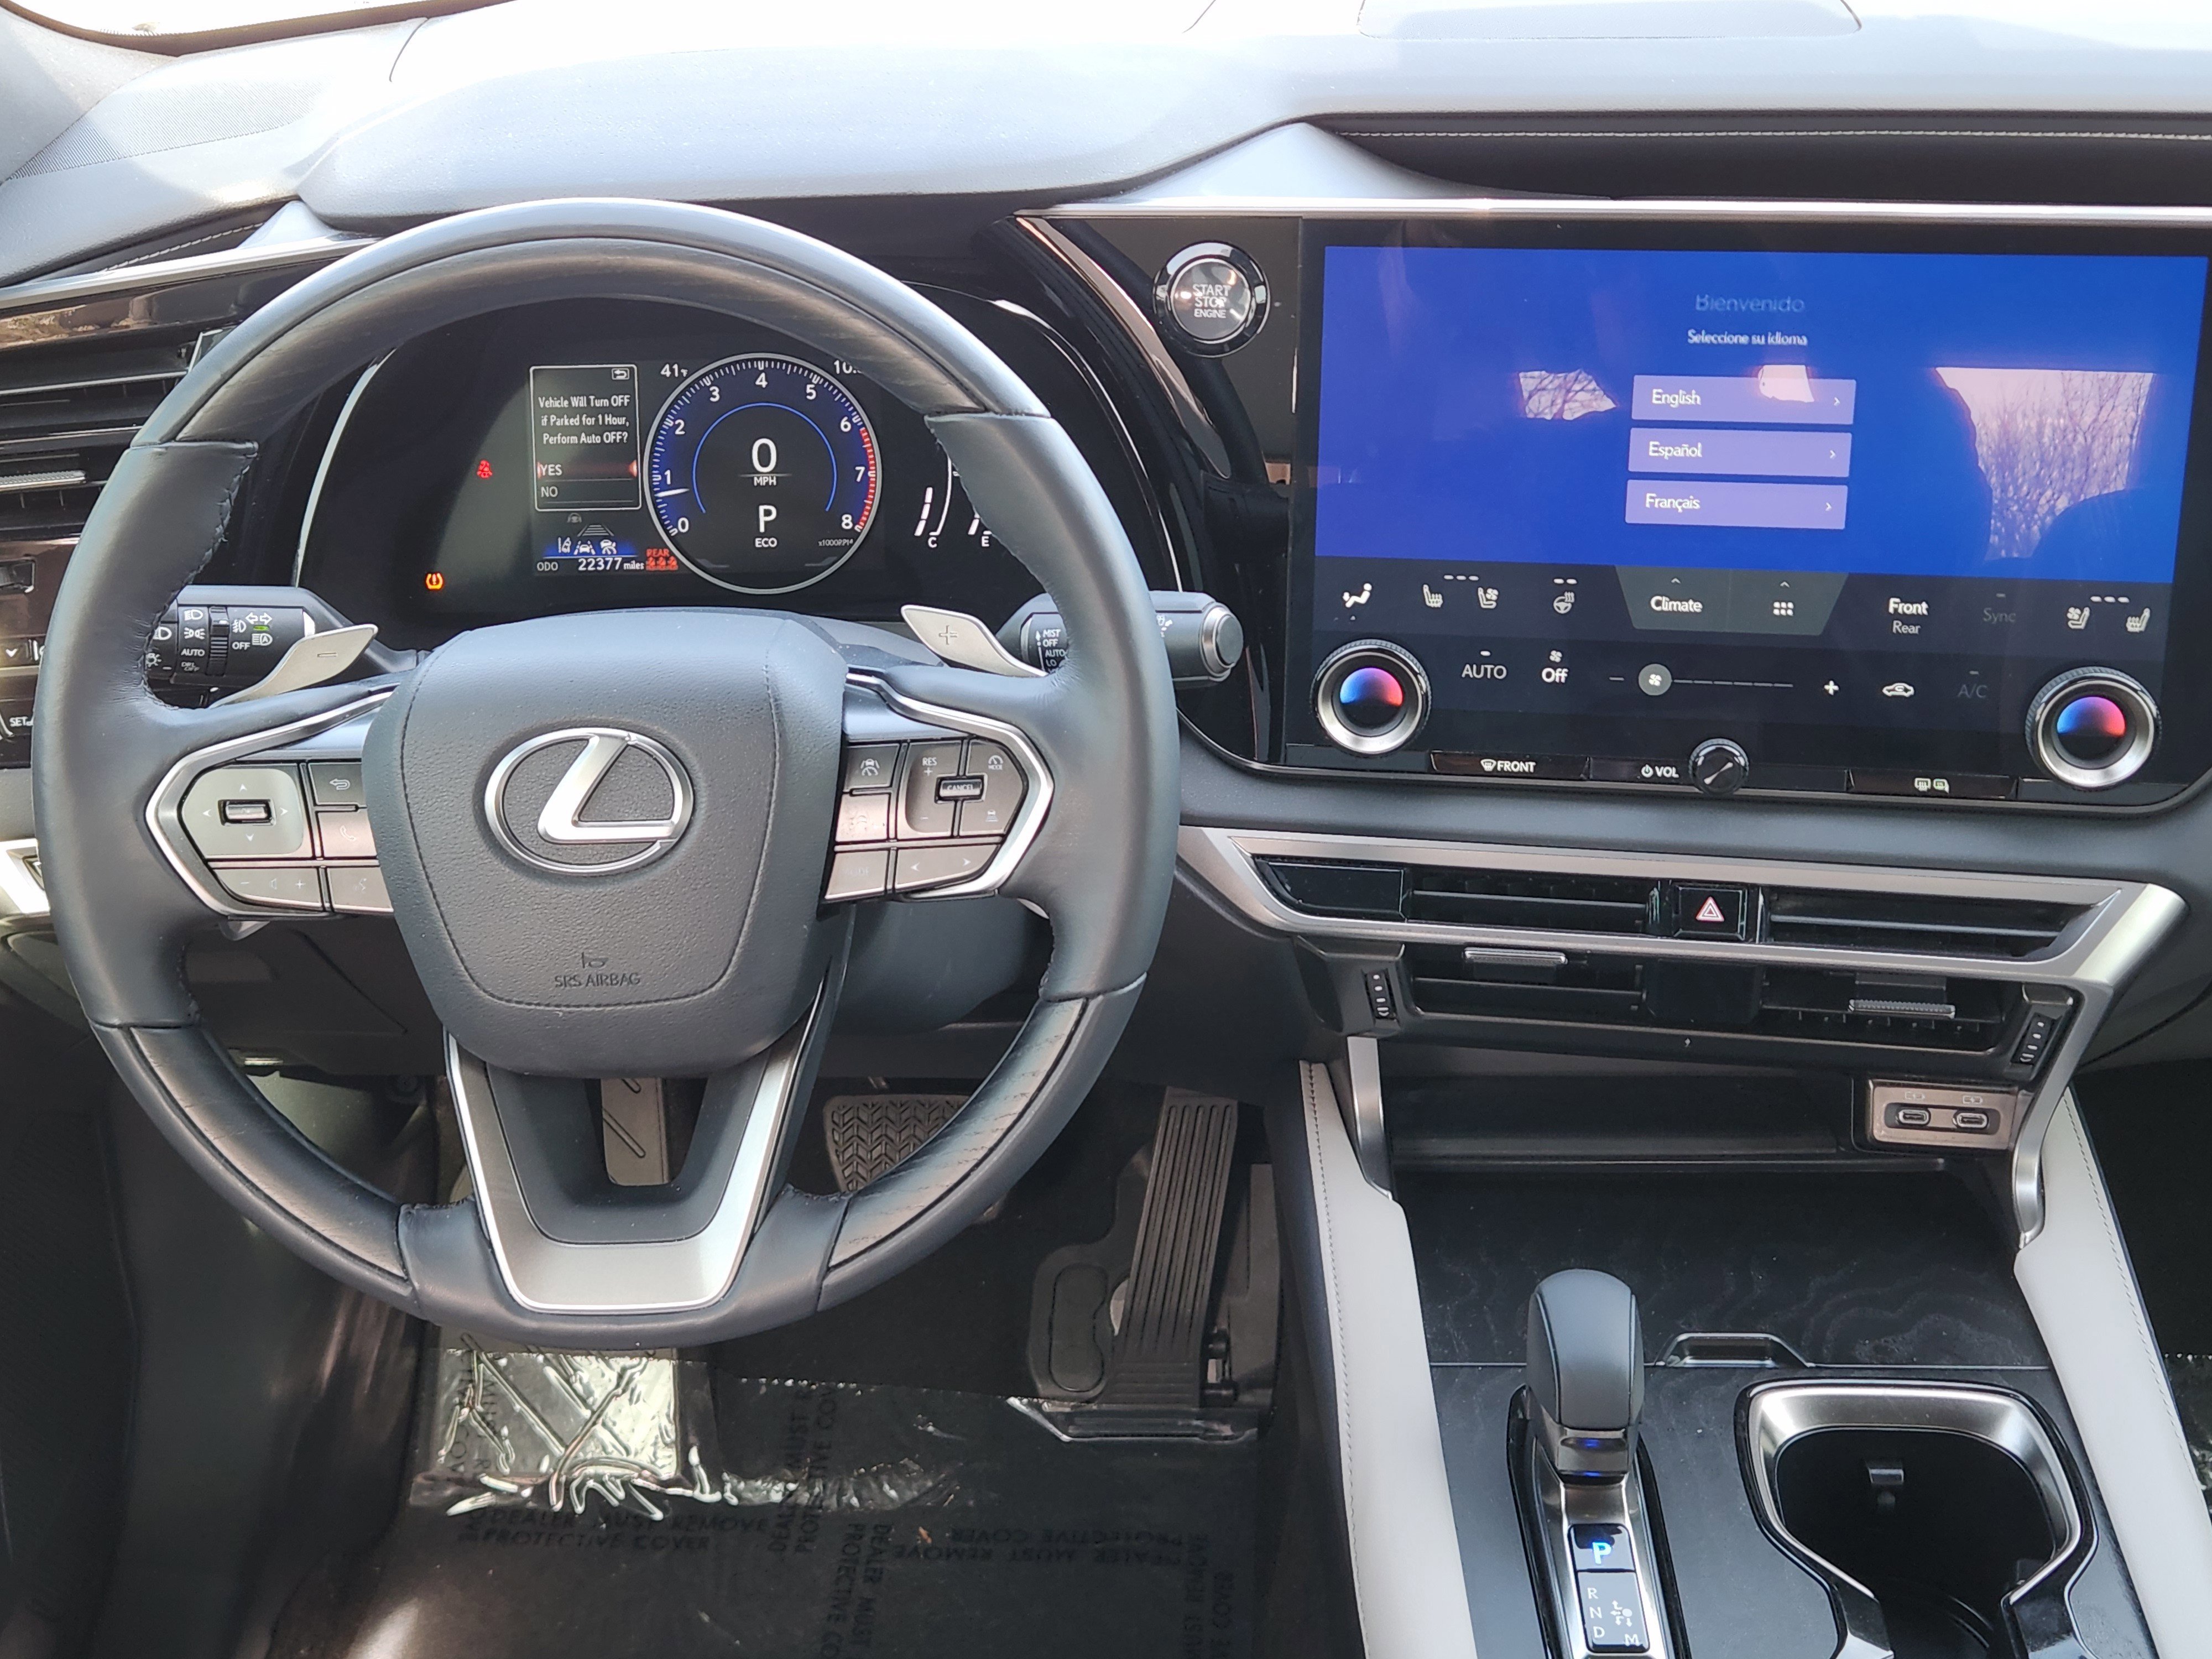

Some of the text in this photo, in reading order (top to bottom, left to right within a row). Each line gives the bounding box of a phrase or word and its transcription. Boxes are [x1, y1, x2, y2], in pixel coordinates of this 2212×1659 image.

[1192, 284, 1232, 296] START
[1194, 296, 1227, 308] STOP
[1695, 294, 1805, 312] Bienvenido
[1194, 309, 1227, 319] ENGINE
[1687, 328, 1808, 346] Seleccione su idioma
[755, 373, 768, 388] 4
[709, 387, 719, 402] 3
[806, 384, 816, 400] 5
[1652, 389, 1702, 408] English
[538, 395, 630, 408] Vehicle Will Turn OFF
[541, 414, 629, 427] if Parked for 1 Hour,
[675, 420, 685, 435] 2
[840, 417, 852, 432] 6
[543, 431, 628, 445] Perform Auto OFF?
[752, 438, 777, 473] 0
[1648, 441, 1703, 460] Español
[540, 464, 562, 476] YES
[855, 467, 865, 482] 7
[664, 470, 672, 485] 1
[754, 476, 776, 486] MPH
[541, 486, 558, 497] NO
[1645, 493, 1700, 513] Français
[678, 518, 689, 533] 0
[759, 505, 777, 533] P
[841, 514, 853, 530] 8
[755, 538, 778, 547] ECO
[928, 537, 937, 548] C
[982, 536, 989, 547] E
[646, 549, 670, 557] REAR
[537, 557, 644, 571] ODO 22377 miles
[1650, 596, 1703, 613] Climate
[1888, 597, 1929, 615] Front
[1983, 608, 2016, 624] Sync
[1042, 629, 1062, 638] MIST
[1893, 620, 1921, 635] Rear
[232, 641, 251, 650] OFF
[1042, 638, 1058, 647] OFF
[1045, 649, 1066, 658] AUTO
[1046, 659, 1057, 667] LO
[1462, 664, 1507, 680] AUTO
[1542, 668, 1569, 684] Off
[1957, 684, 1988, 699] A/C
[922, 757, 937, 766] RES
[1497, 760, 1536, 774] FRONT
[1655, 766, 1679, 778] VOL
[555, 972, 640, 988] SRS AIRBAG
[1592, 1541, 1612, 1564] P
[1587, 1588, 1598, 1599] R
[1589, 1606, 1603, 1619] N
[1593, 1626, 1605, 1638] D
[1624, 1634, 1640, 1646] M
